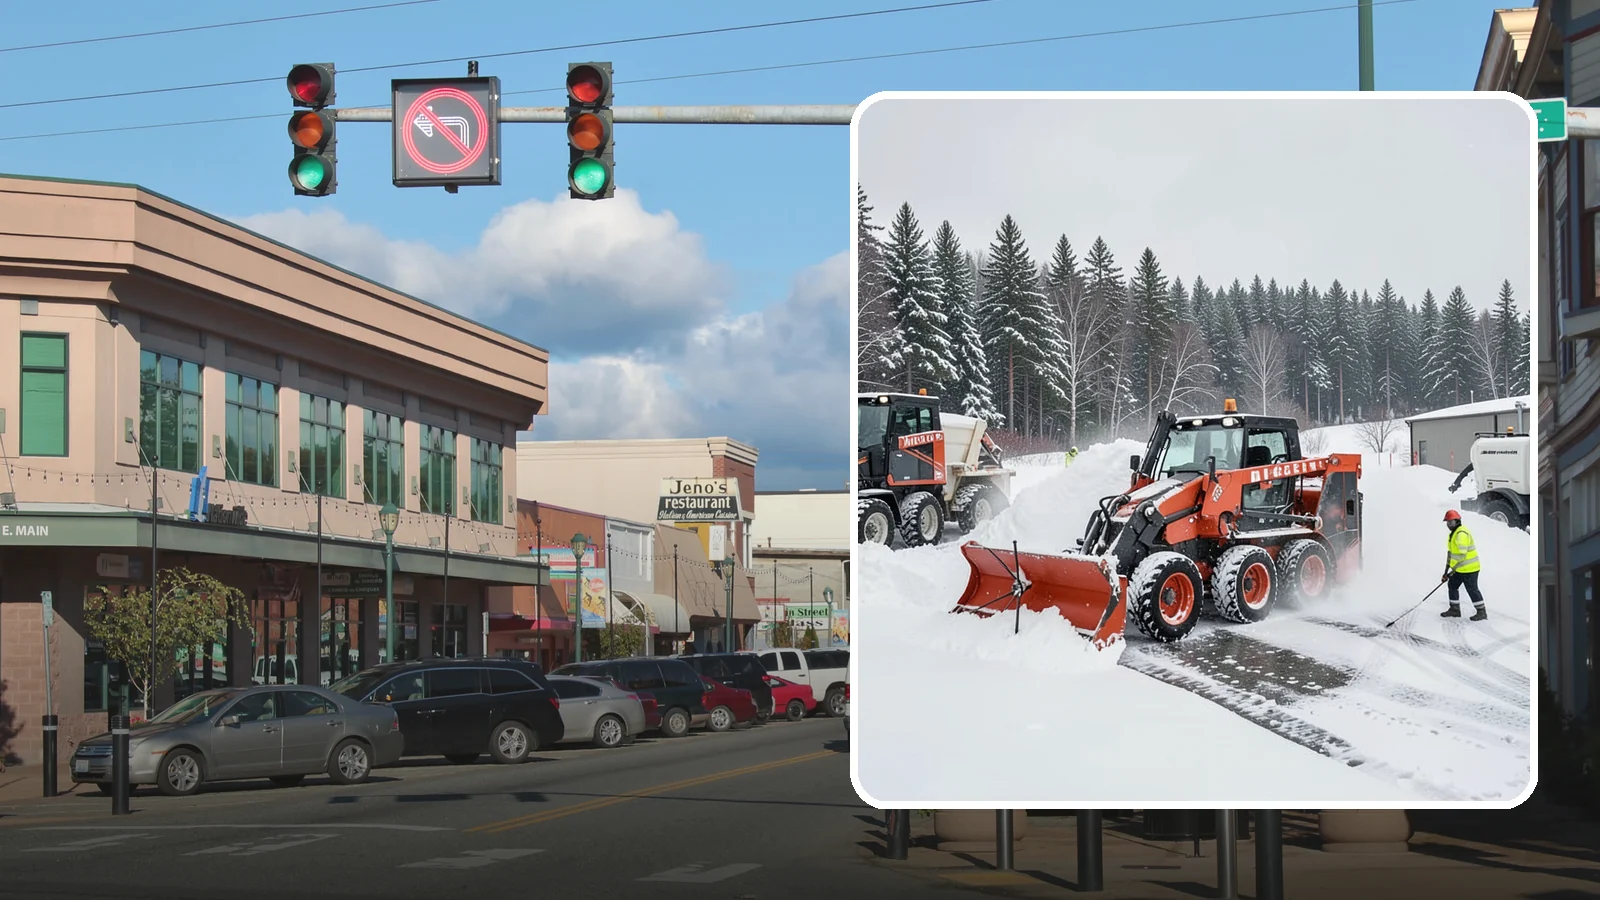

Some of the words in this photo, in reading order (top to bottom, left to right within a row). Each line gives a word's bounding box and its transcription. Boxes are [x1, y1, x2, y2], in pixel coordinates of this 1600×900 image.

[669, 480, 728, 494] Jeno's
[665, 496, 731, 509] restaurant
[658, 510, 682, 519] Italian
[685, 509, 715, 519] American
[715, 509, 738, 519] Cuisine
[2, 525, 13, 536] E.
[15, 525, 49, 537] MAIN
[797, 607, 828, 617] Street
